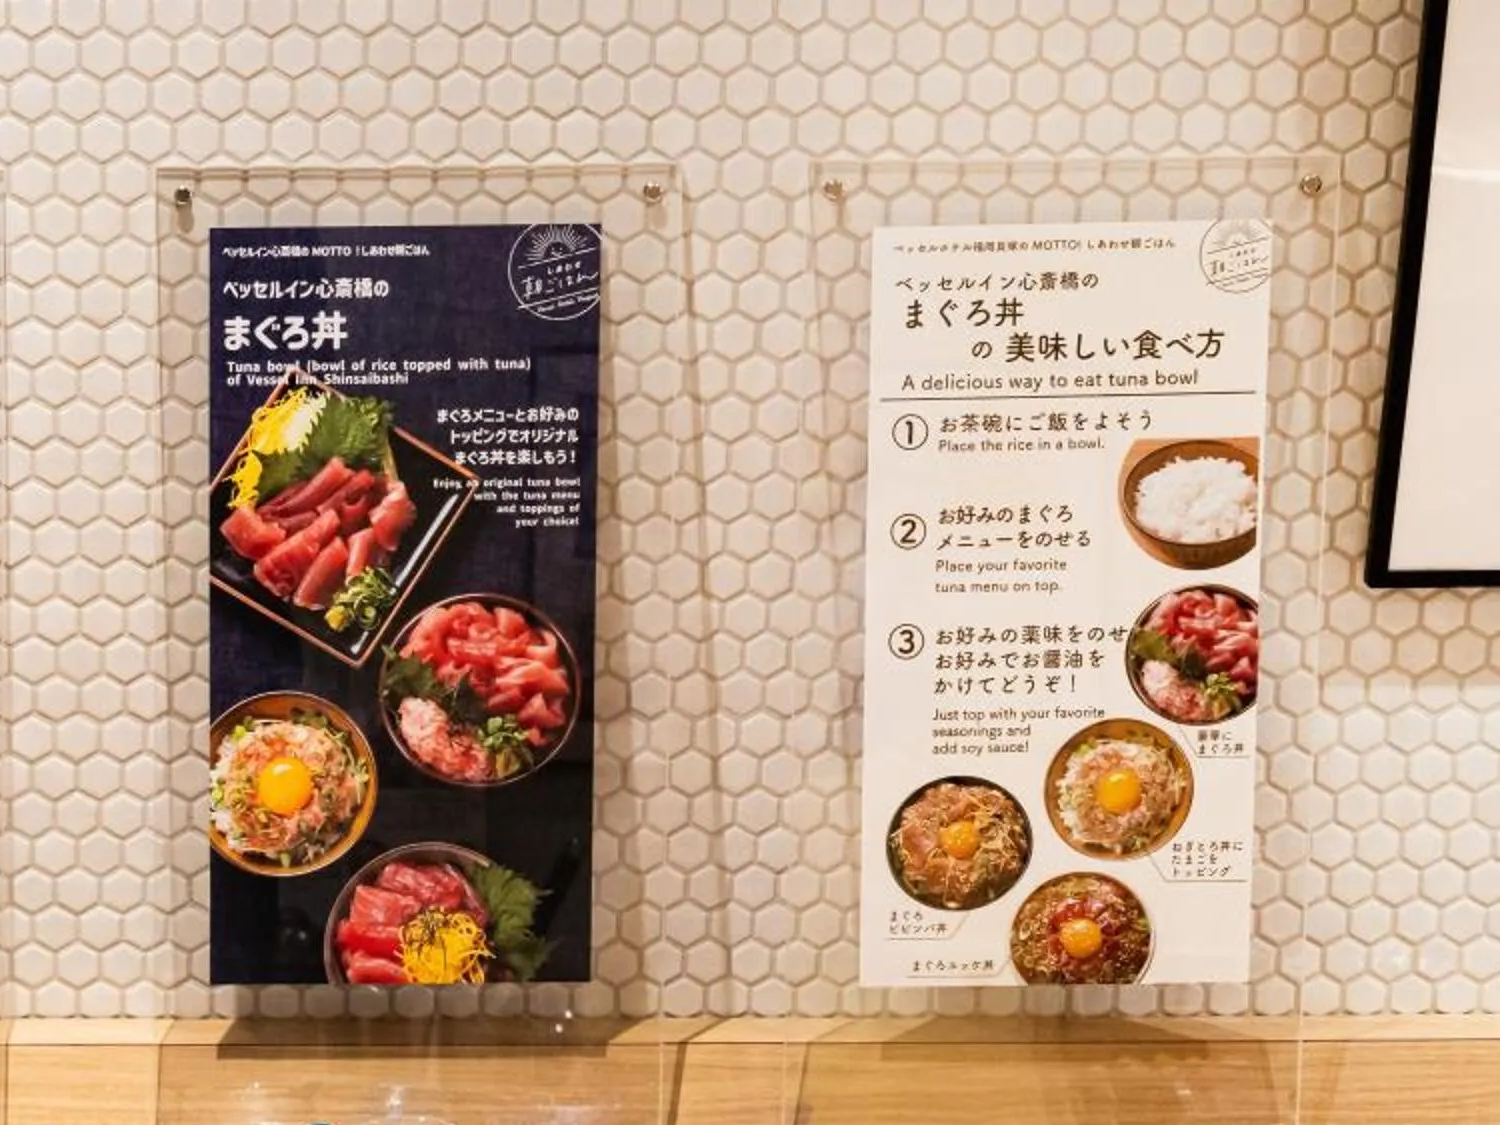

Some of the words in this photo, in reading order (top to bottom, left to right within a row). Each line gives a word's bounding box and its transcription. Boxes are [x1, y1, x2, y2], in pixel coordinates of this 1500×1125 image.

[223, 278, 390, 299] ベッセルイン心斎橋の
[896, 271, 1099, 292] ベッセルイン心斎橋の
[905, 297, 1025, 329] まぐろ丼
[223, 310, 348, 351] まぐろ丼
[227, 361, 260, 372] Tuna
[267, 360, 300, 373] bowl
[306, 359, 346, 374] (bowl
[351, 359, 365, 371] of
[371, 358, 396, 371] rice
[403, 358, 451, 374] topped
[458, 358, 489, 370] with
[494, 357, 531, 371] tuna)
[227, 373, 241, 386] of
[247, 374, 289, 386] Vessel
[324, 372, 409, 385] Shinsaibashi
[901, 375, 915, 391] A
[921, 374, 1003, 391] delicious
[1008, 376, 1043, 393] way
[1050, 374, 1068, 388] to
[1074, 373, 1102, 388] eat
[1108, 373, 1149, 388] tuna
[1155, 369, 1199, 386] bowl
[437, 407, 579, 423] まぐろメニューとお好みの
[940, 410, 1152, 433] お茶碗にご飯をよそう
[451, 427, 579, 444] トッピングでオリジナル
[938, 439, 978, 452] Place
[980, 438, 1004, 451] the
[1008, 437, 1033, 450] rice
[1037, 437, 1051, 450] in
[1055, 440, 1063, 450] a
[1067, 436, 1105, 450] bowl.
[483, 477, 523, 490] original
[527, 477, 551, 488] tuna
[555, 476, 581, 488] bowl
[938, 504, 1073, 525] お好みのまぐろ
[936, 530, 1091, 551] メニューをのせる
[935, 559, 973, 573] Place
[977, 561, 1009, 575] your
[1013, 557, 1067, 571] favorite
[935, 583, 966, 593] tuna
[970, 583, 1008, 593] menu
[1013, 583, 1031, 592] on
[935, 624, 1129, 645] お好みの薬味をのせ
[935, 650, 1105, 670] お好みでお醤油を
[934, 674, 1077, 695] かけてどうぞ！
[932, 708, 959, 721] Just
[963, 708, 985, 723] top
[989, 707, 1017, 720] with
[1020, 709, 1050, 722] your
[1055, 705, 1105, 719] favorite
[932, 726, 1003, 740] seasonings
[1006, 724, 1031, 736] and
[932, 743, 958, 755] add
[961, 744, 983, 757] soy
[987, 741, 1030, 753] sauce!
